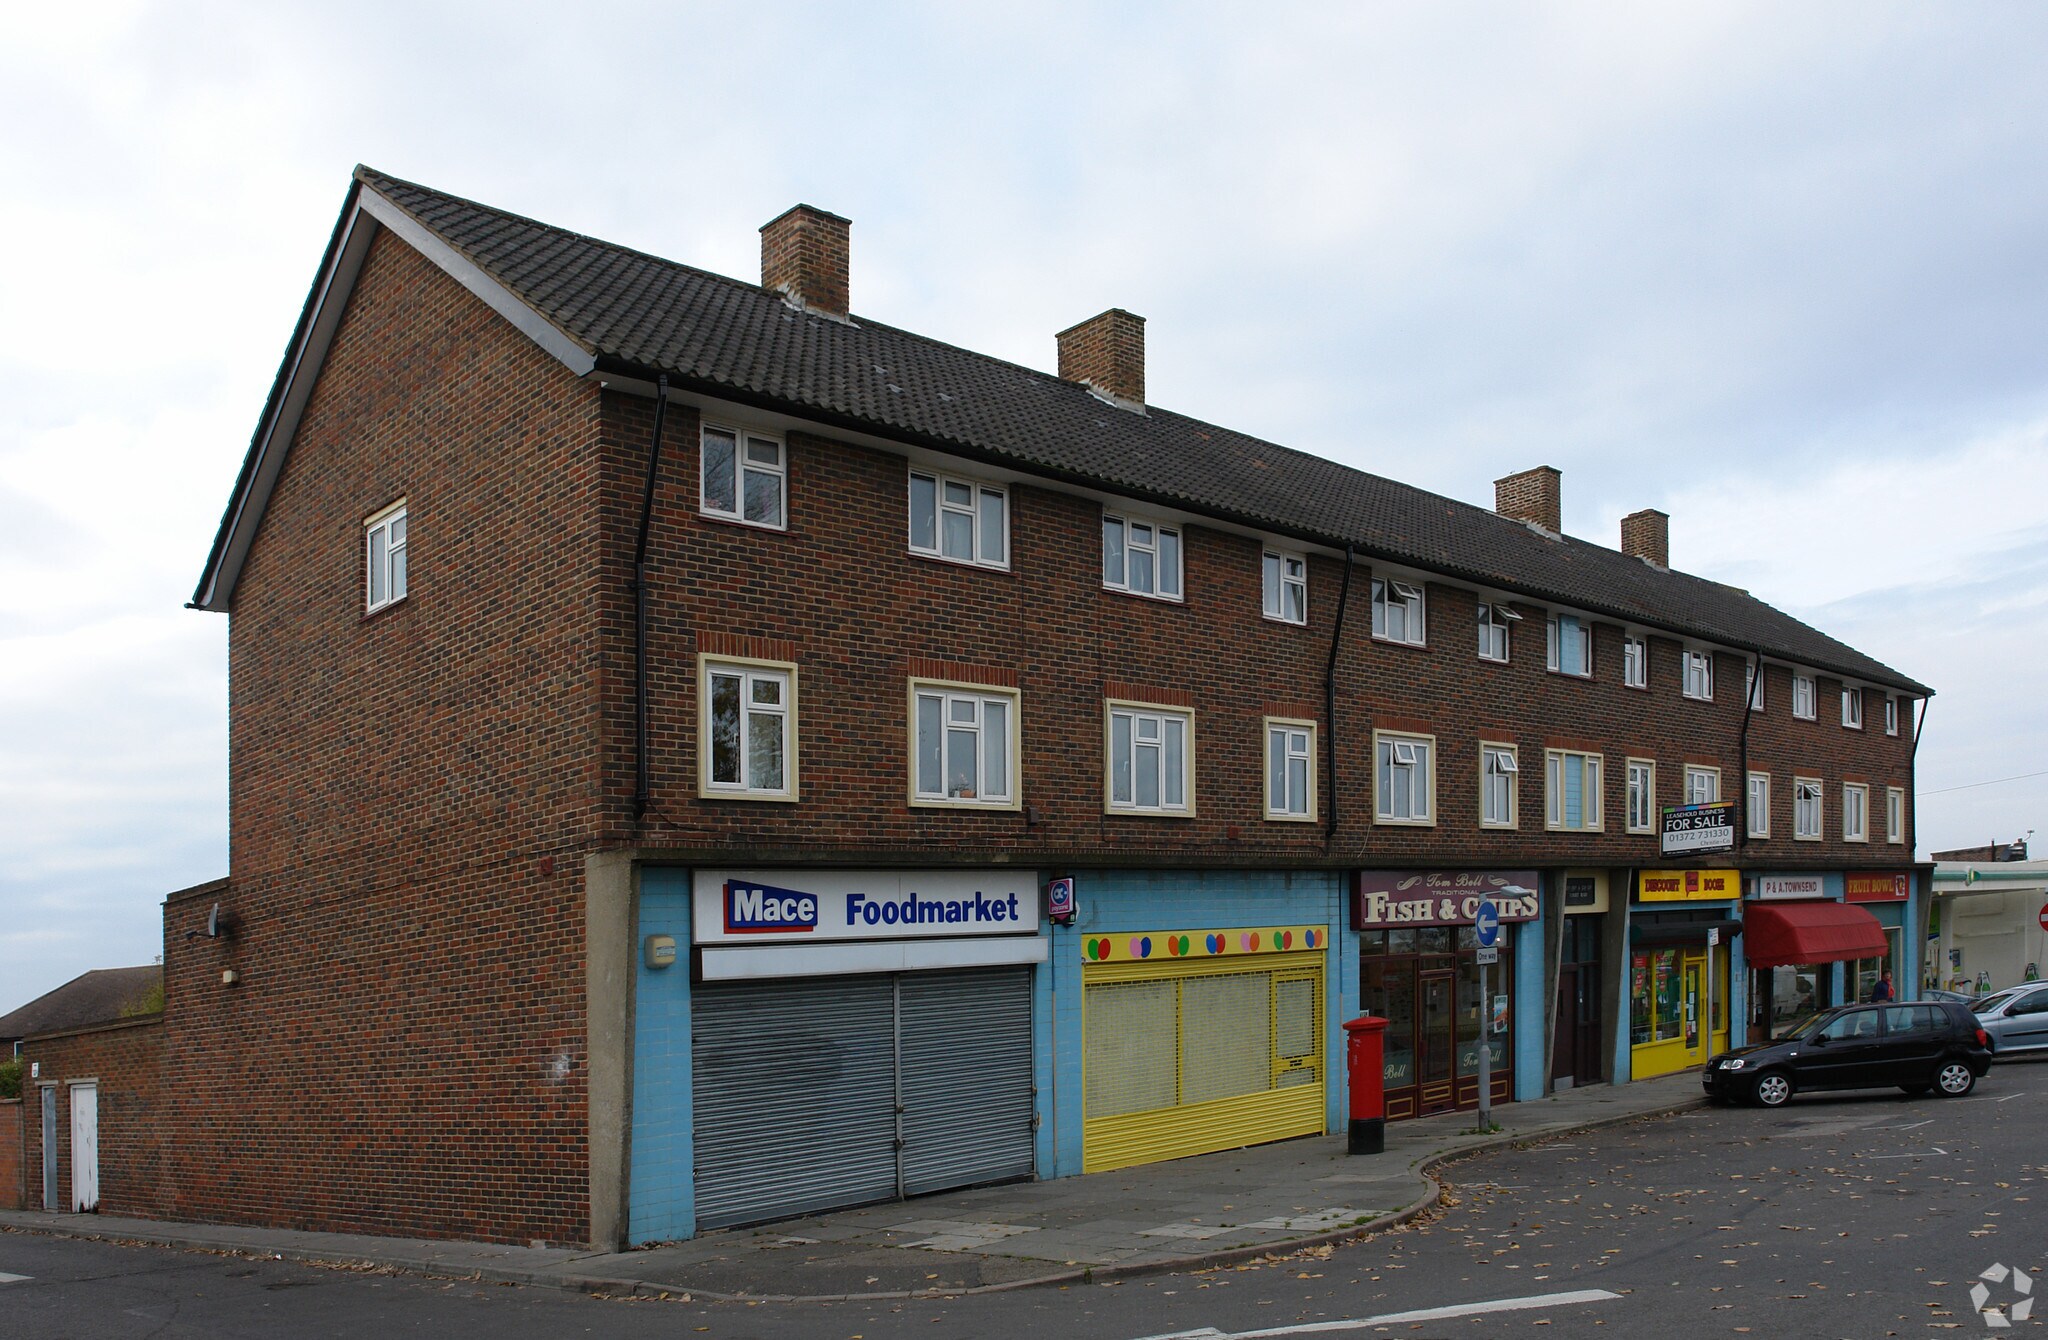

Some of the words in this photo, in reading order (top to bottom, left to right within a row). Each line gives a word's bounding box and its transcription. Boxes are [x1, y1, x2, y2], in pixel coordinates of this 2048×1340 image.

[1666, 811, 1697, 819] LEASEHOLD
[1698, 808, 1725, 816] BUSINESS
[1666, 819, 1690, 831] FOR
[1694, 815, 1725, 828] SALE
[1669, 832, 1695, 842] 01372
[1698, 829, 1729, 839] 731330
[1426, 873, 1451, 887] Tom
[1455, 873, 1485, 887] Bell
[1645, 879, 1680, 892] DISCOUNT
[1848, 879, 1871, 893] FRUIT
[1871, 878, 1895, 892] BOWL
[1766, 882, 1770, 893] P
[1772, 882, 1776, 893] &
[734, 889, 815, 922] Mace
[846, 891, 1019, 926] Foodmarket
[1439, 899, 1457, 920] &
[1478, 952, 1487, 960] One
[1383, 1064, 1407, 1080] Bell
